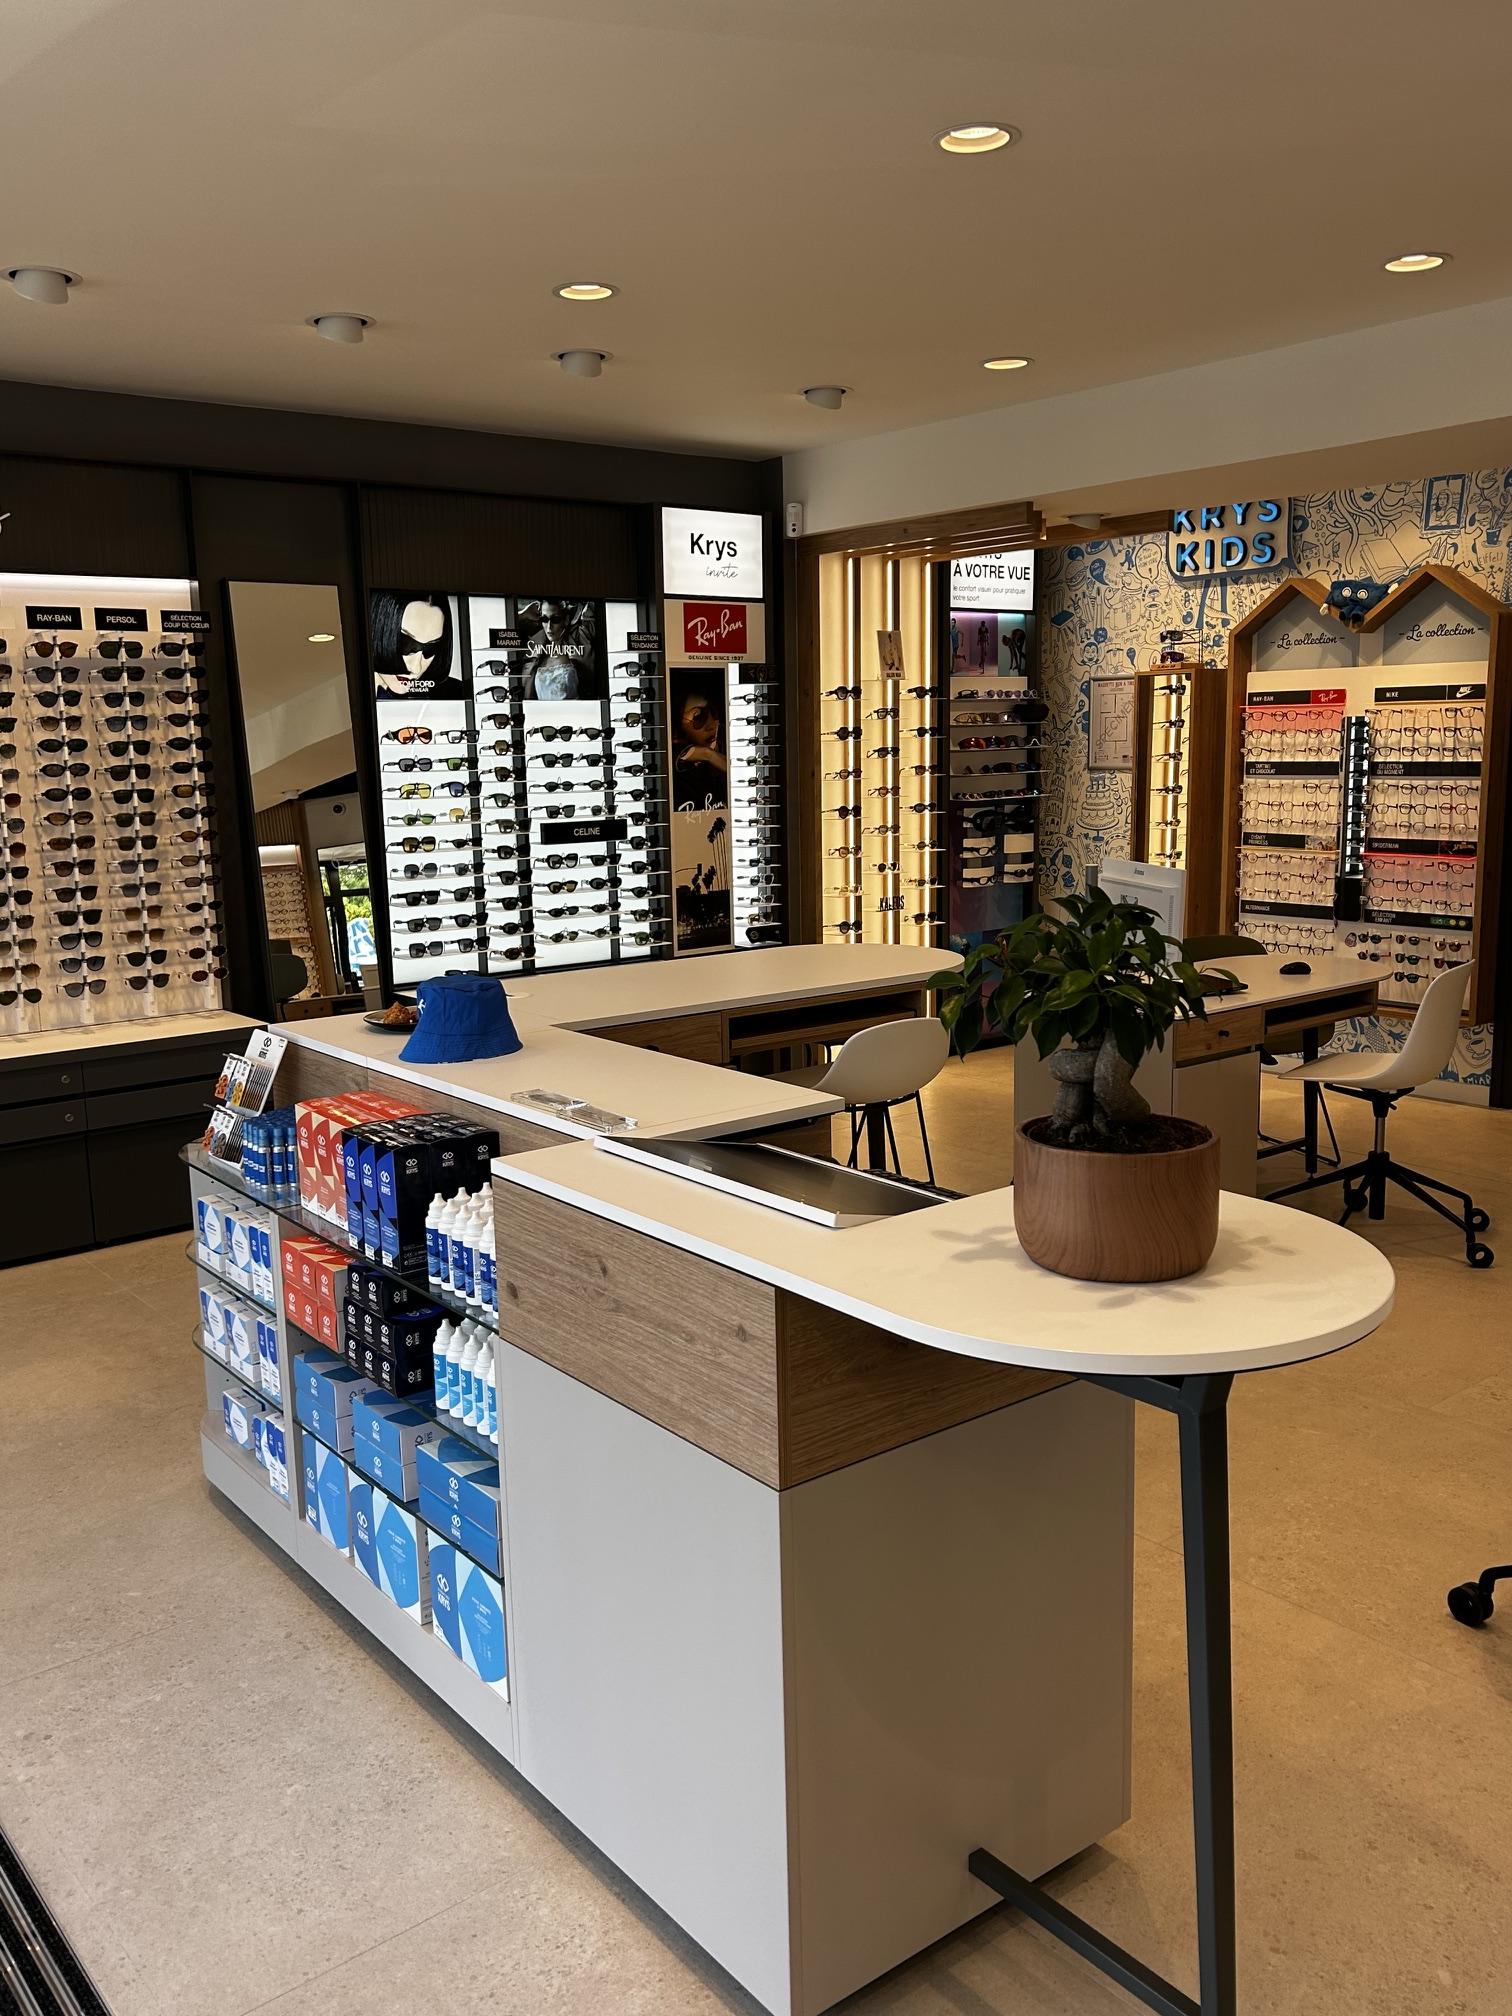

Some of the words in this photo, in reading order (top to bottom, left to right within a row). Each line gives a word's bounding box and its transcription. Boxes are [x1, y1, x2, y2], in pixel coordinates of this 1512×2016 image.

[1173, 500, 1282, 533] KRYS
[690, 532, 738, 561] Krys
[1176, 532, 1276, 573] KIDS
[705, 563, 739, 579] invite
[953, 559, 962, 577] À
[965, 563, 1005, 579] VOTRE
[1007, 565, 1031, 580] VUE
[36, 614, 72, 623] RAY-BAN
[106, 615, 137, 624] PERSOL
[170, 614, 202, 622] SÉLECTION
[687, 608, 744, 647] Ray-Ban
[1406, 624, 1424, 641] La
[1425, 623, 1476, 638] collection
[1276, 633, 1292, 649] La
[1293, 631, 1338, 646] collection
[399, 680, 414, 688] TOM
[415, 680, 435, 688] FORD
[573, 827, 601, 836] CELINE
